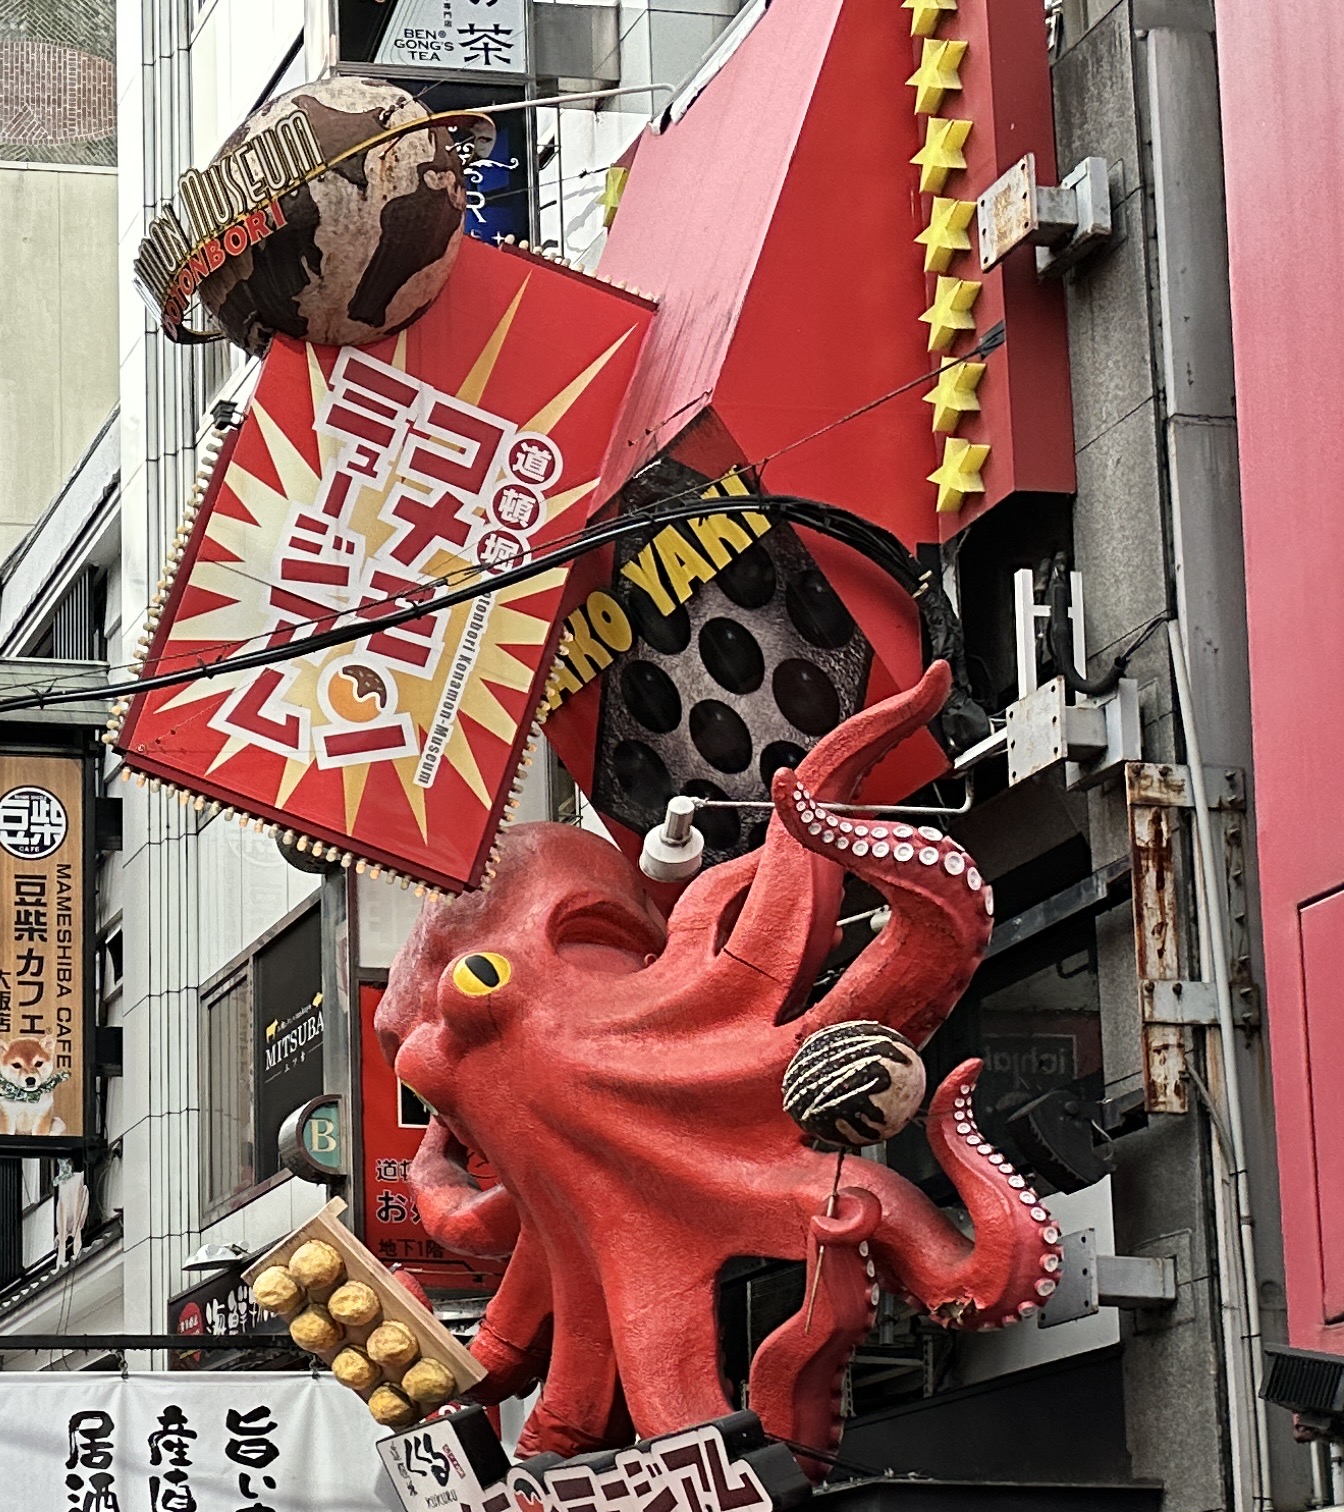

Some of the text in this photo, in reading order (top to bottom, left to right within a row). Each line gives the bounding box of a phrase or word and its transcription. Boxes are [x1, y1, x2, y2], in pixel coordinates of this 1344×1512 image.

[393, 38, 455, 52] GONG'S
[404, 28, 437, 40] BEN
[410, 51, 442, 62] TEA
[178, 109, 328, 248] MUSEUM
[549, 467, 776, 710] AKO YAKI
[418, 654, 474, 785] Konamon-Museum
[14, 873, 48, 1035] 豆柴カフェ
[56, 863, 72, 1069] MAMESHIBA CAFE
[265, 1010, 325, 1072] MITSUBA
[309, 1117, 337, 1153] B
